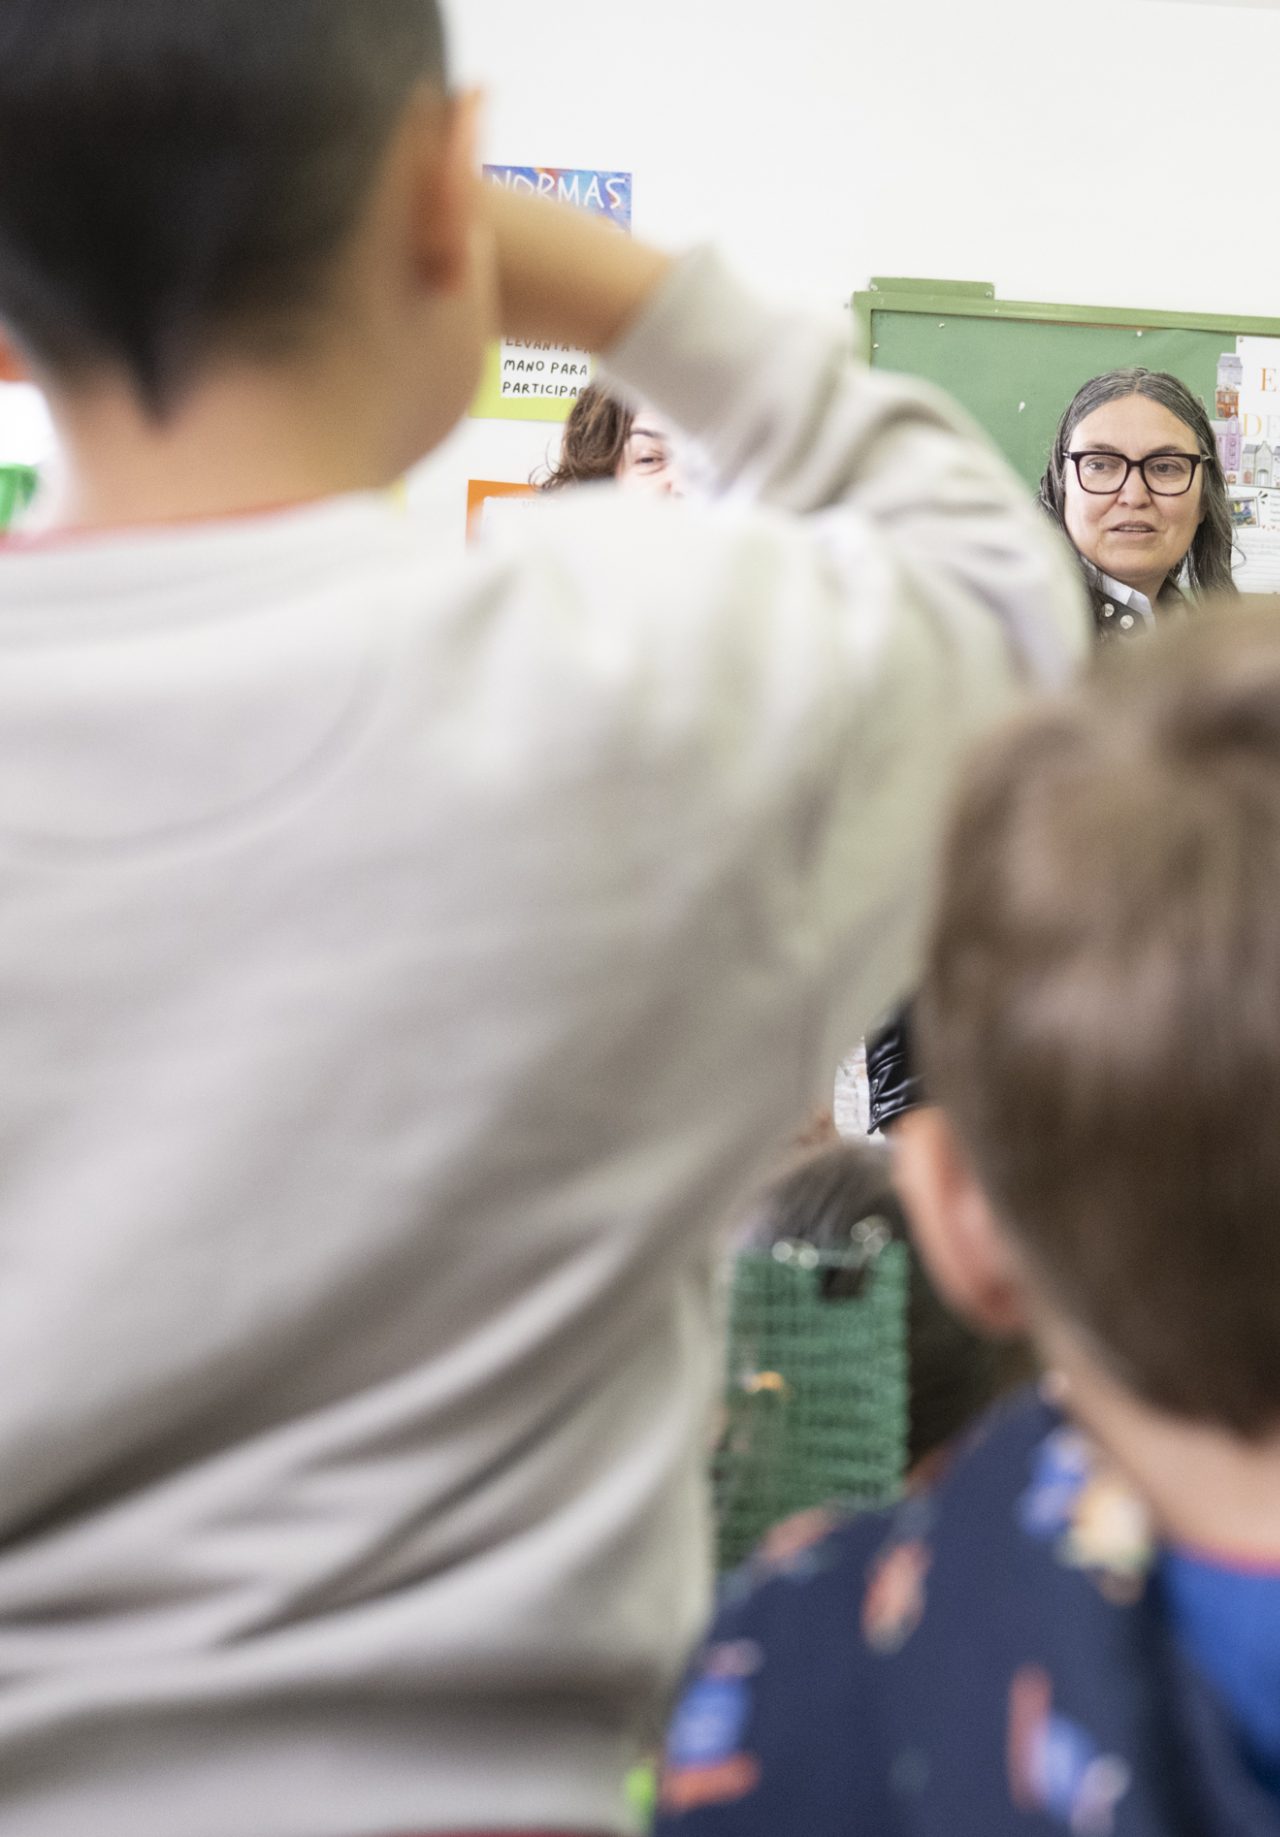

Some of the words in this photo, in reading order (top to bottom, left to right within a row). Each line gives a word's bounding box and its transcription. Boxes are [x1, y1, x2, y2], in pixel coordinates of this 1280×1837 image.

[503, 359, 545, 373] MANO
[550, 361, 588, 376] PARA
[1242, 413, 1280, 438] DE
